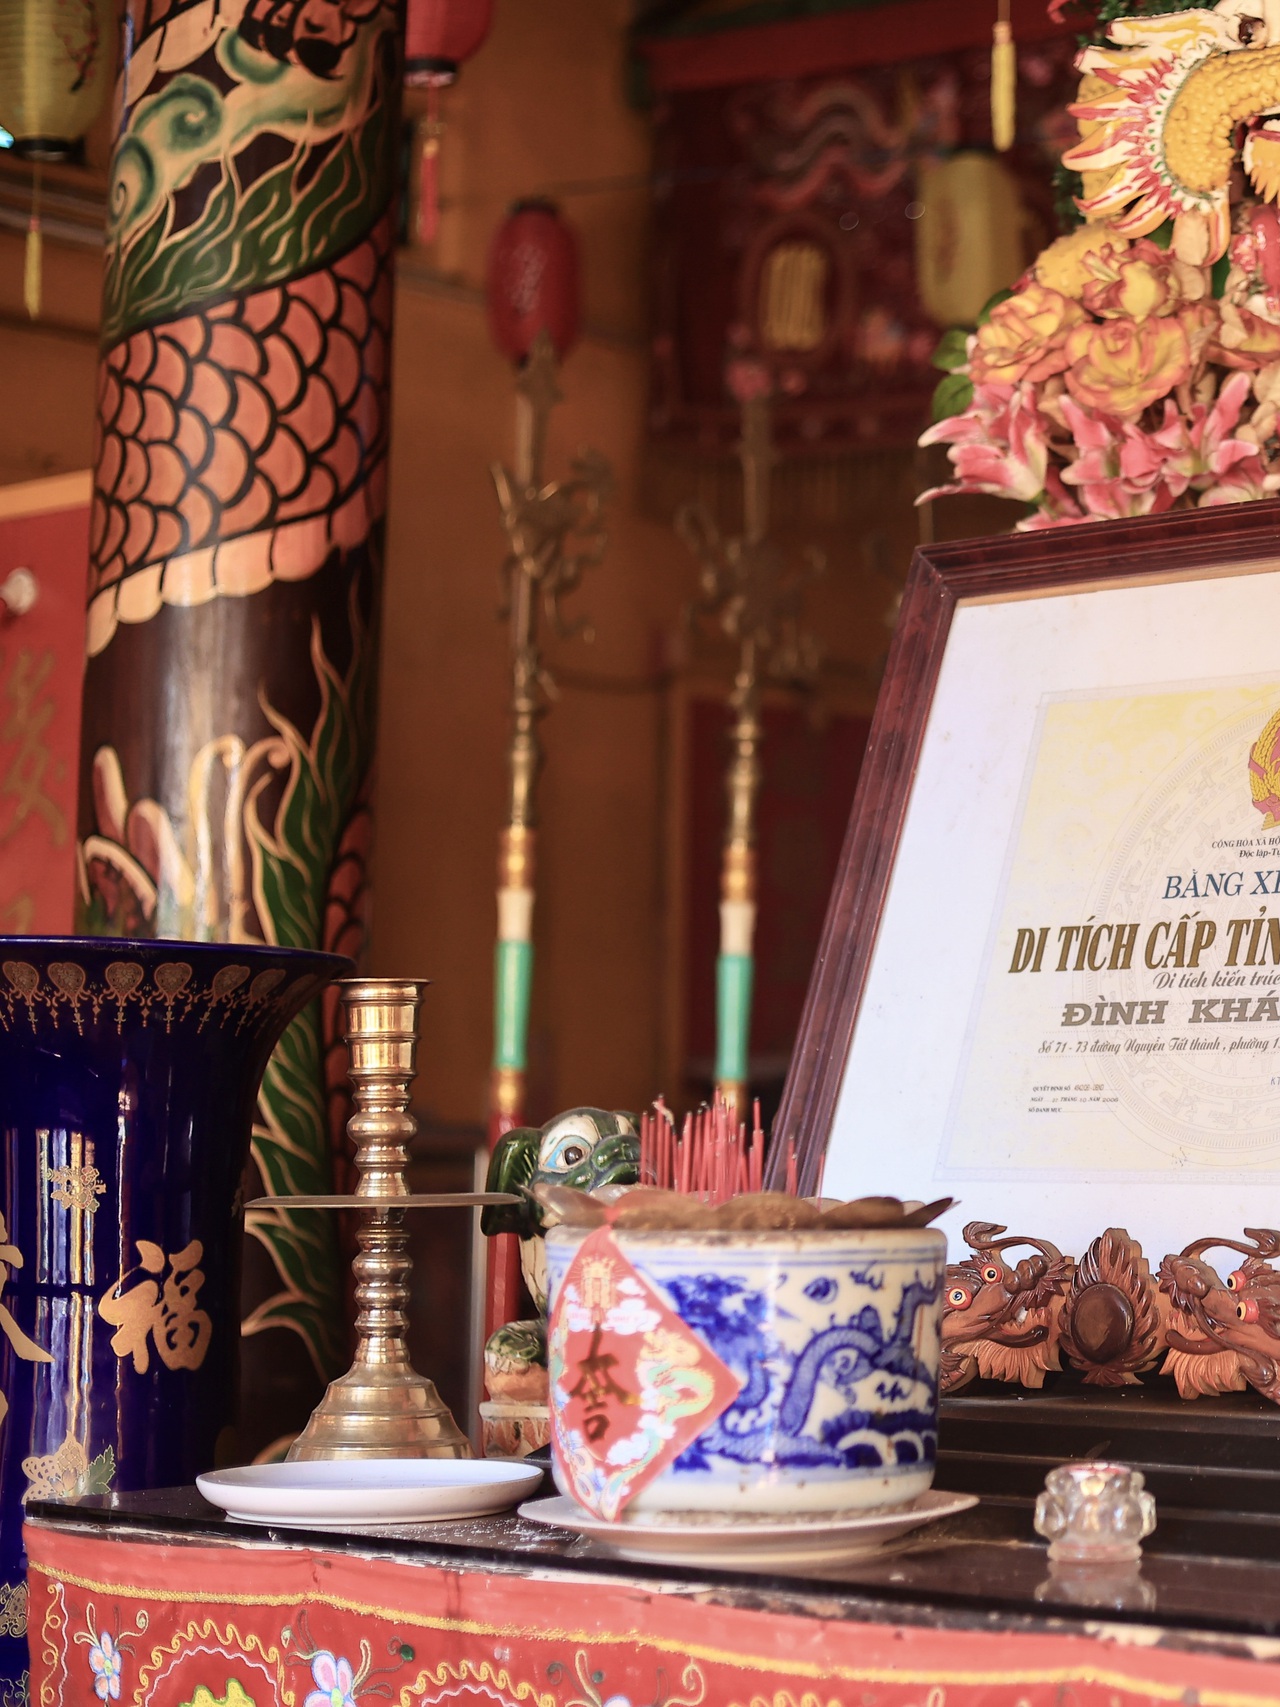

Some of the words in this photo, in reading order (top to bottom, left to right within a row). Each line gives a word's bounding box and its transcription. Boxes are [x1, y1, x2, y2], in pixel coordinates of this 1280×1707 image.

[1161, 868, 1244, 900] BẰNG
[1008, 926, 1051, 974] DI
[1055, 915, 1141, 972] TÍCH
[1144, 911, 1217, 970] CẤP
[1153, 971, 1177, 989] Di
[1178, 971, 1208, 988] tích
[1211, 969, 1246, 987] kiến
[1249, 970, 1280, 986] trúc
[1060, 995, 1168, 1027] ĐÌNH
[1038, 1040, 1054, 1054] Số
[1055, 1041, 1068, 1053] 71
[1076, 1041, 1089, 1053] 73
[1090, 1039, 1121, 1055] đường
[1190, 1037, 1221, 1050] thành
[1230, 1035, 1269, 1054] phường
